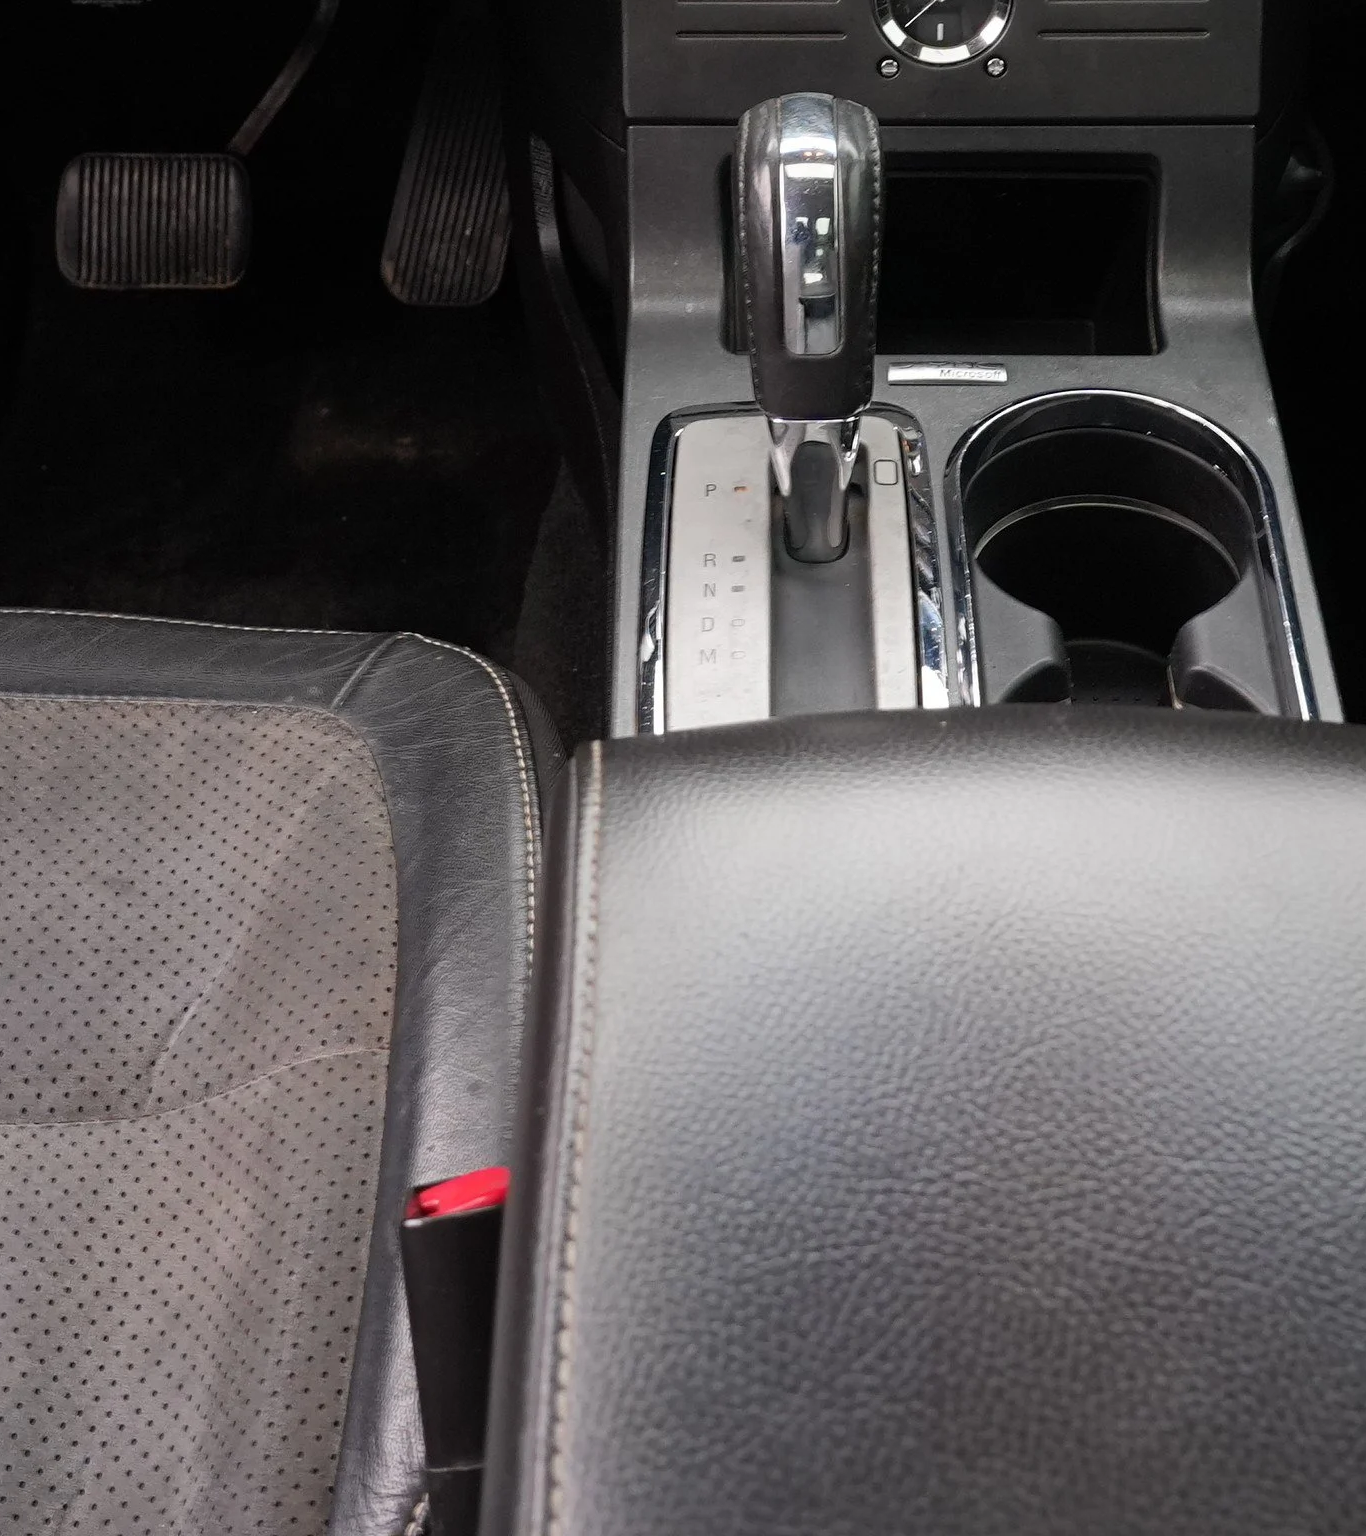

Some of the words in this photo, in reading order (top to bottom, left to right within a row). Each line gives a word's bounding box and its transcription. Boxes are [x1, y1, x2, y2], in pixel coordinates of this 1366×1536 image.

[939, 368, 1003, 381] Microsoft
[705, 483, 718, 498] P
[703, 552, 718, 568] R
[703, 582, 717, 599] N
[701, 616, 716, 633] D
[700, 648, 718, 665] M
